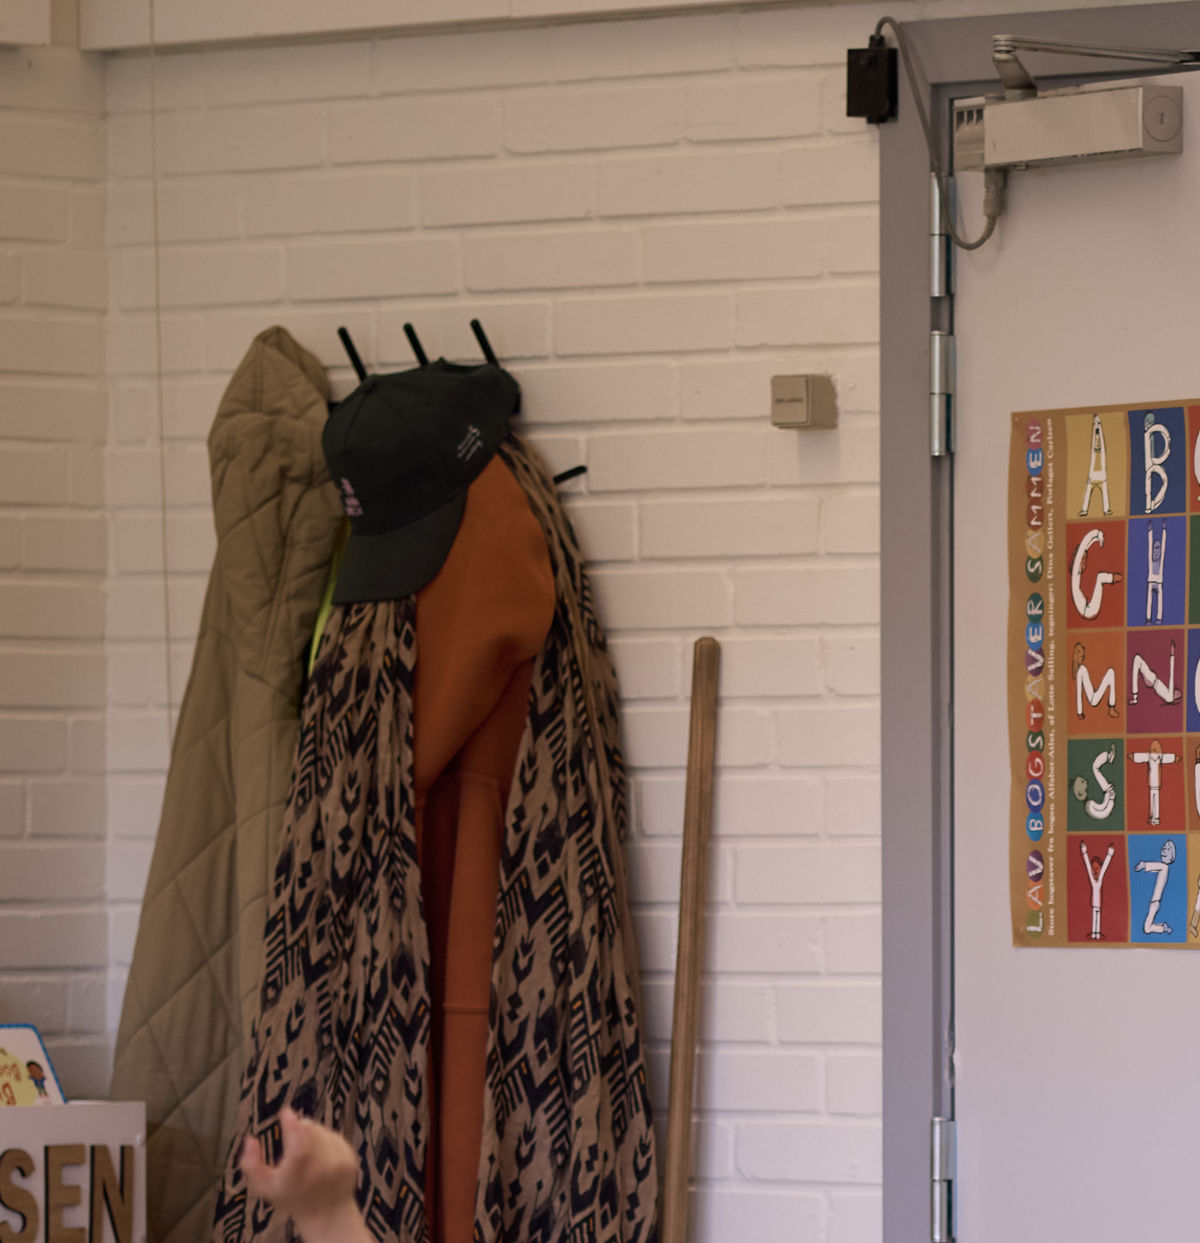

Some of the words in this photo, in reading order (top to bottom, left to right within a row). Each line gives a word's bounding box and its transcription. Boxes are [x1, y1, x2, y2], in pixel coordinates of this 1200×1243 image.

[1027, 425, 1043, 574] SAMMEN
[1078, 413, 1113, 517] A
[1144, 412, 1171, 514] B
[1070, 529, 1123, 621] G
[1146, 518, 1167, 624] H
[1026, 599, 1044, 831] BOGSTAVER
[1072, 642, 1119, 719] M
[1128, 640, 1182, 707] N
[1071, 743, 1117, 820] S
[1127, 740, 1182, 825] T
[1026, 854, 1044, 932] LAV
[1080, 840, 1116, 940] Y
[1134, 839, 1176, 934] Z
